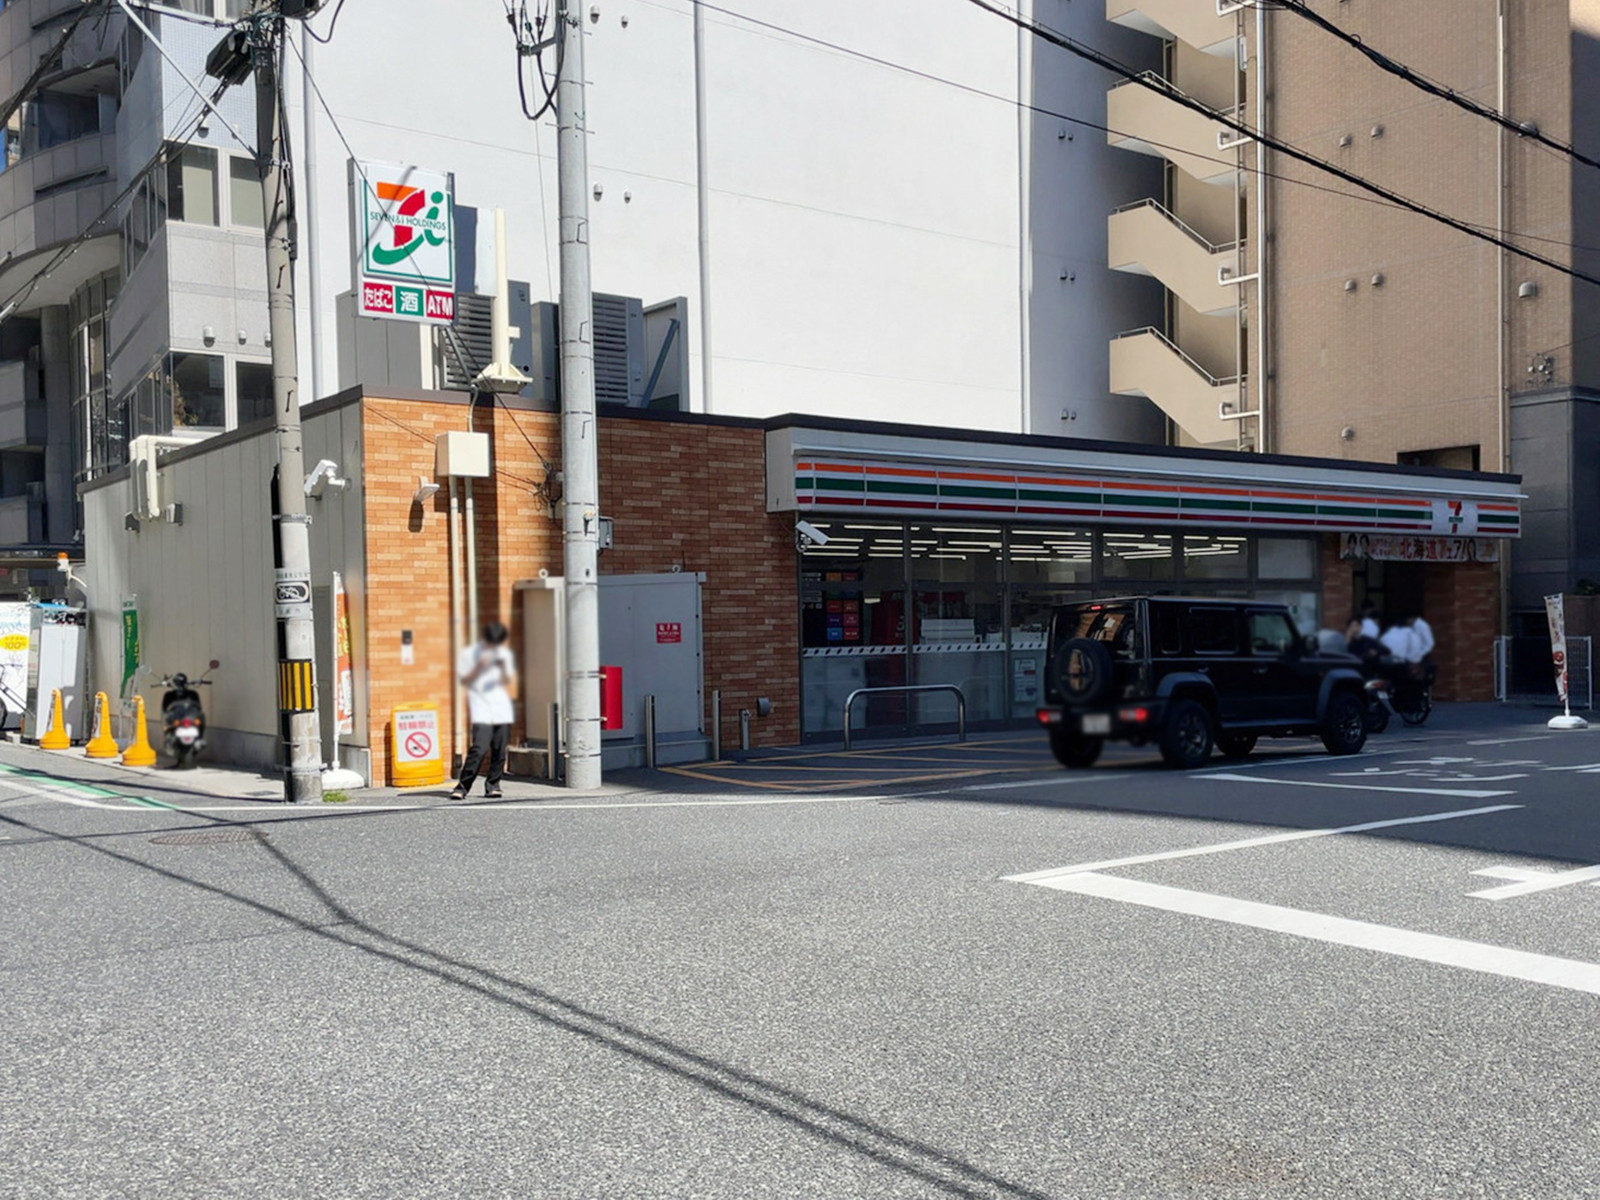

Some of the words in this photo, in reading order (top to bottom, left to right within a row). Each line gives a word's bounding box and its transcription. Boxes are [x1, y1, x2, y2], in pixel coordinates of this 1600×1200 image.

[406, 217, 446, 230] HOLDINGS
[364, 288, 393, 308] たばこ
[401, 291, 419, 312] 酒
[428, 295, 452, 316] ATM
